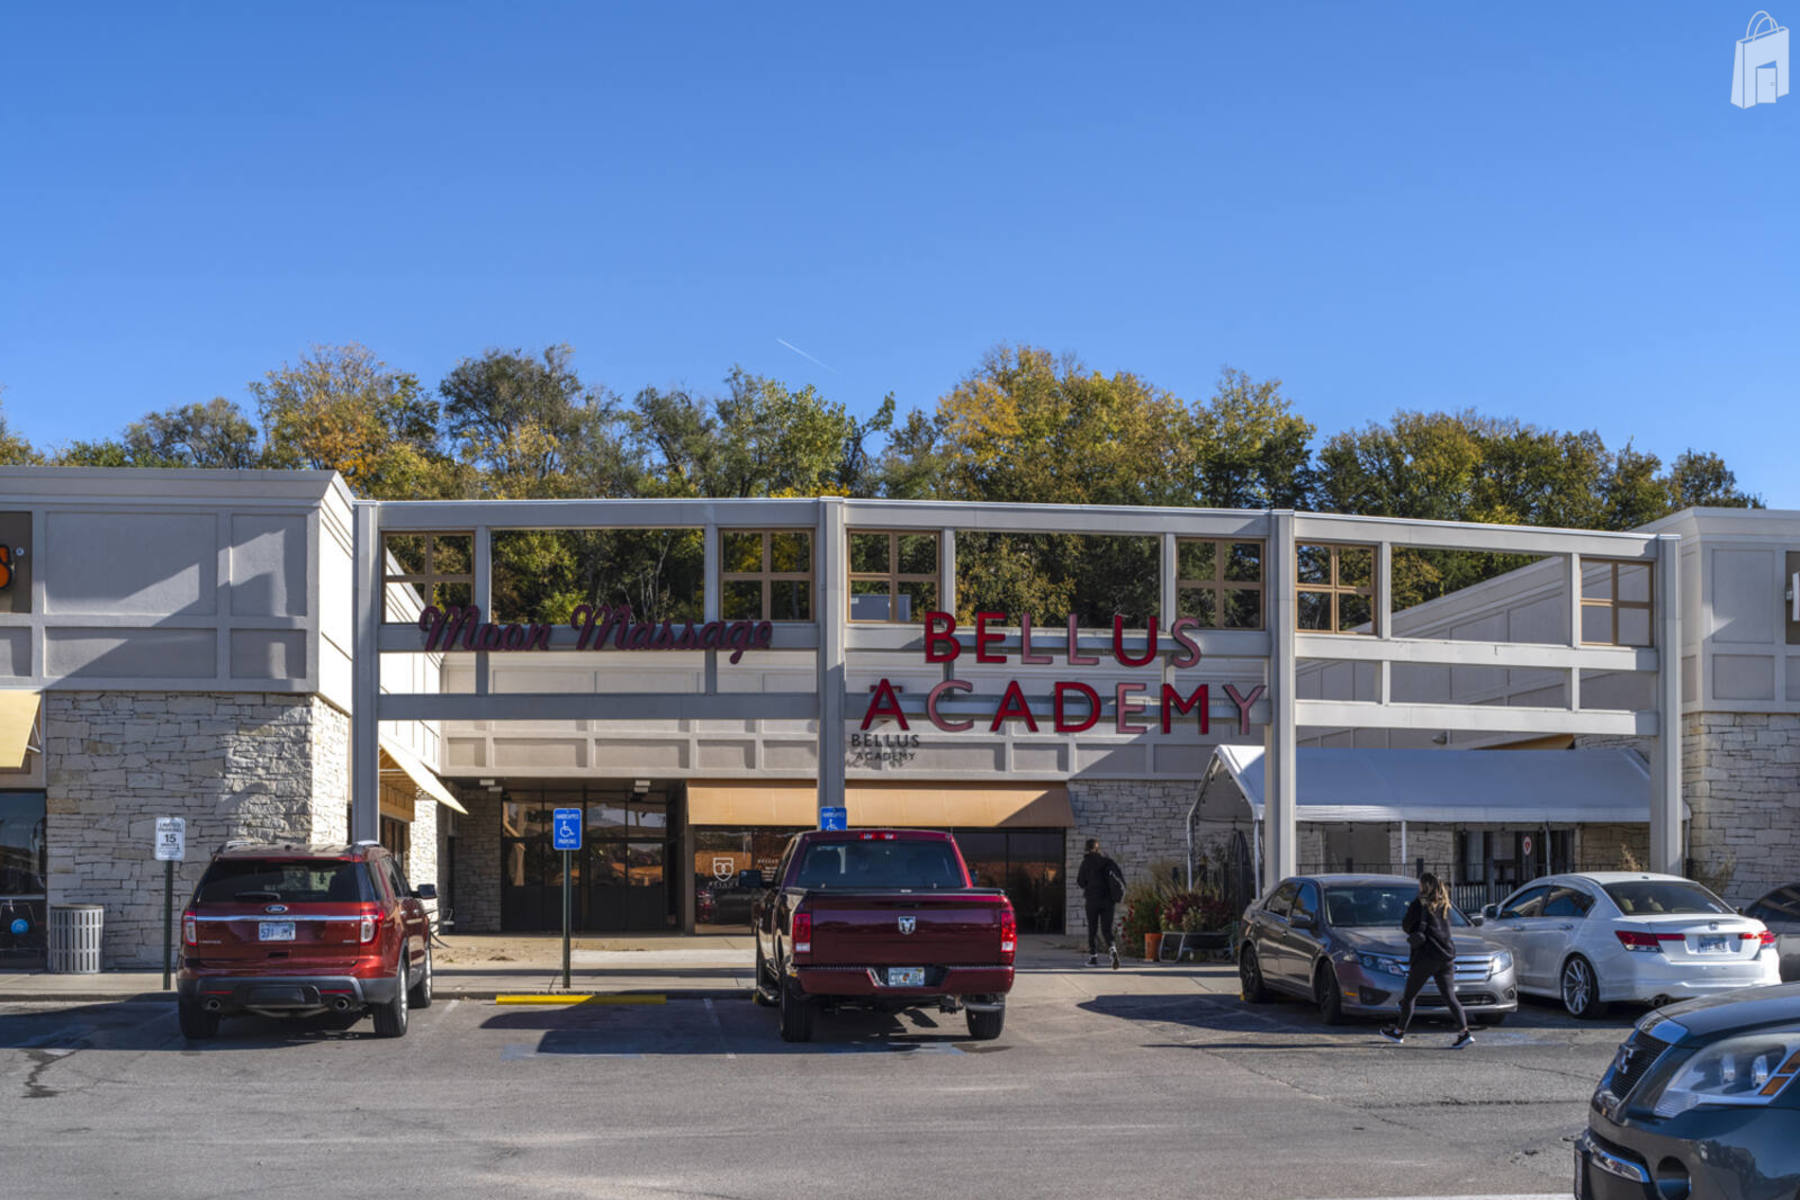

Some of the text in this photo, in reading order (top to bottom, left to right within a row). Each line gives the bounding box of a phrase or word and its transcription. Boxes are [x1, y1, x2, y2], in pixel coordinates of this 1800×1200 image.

[419, 604, 773, 665] Moon Massage
[924, 611, 1202, 668] BELLUS
[860, 678, 1266, 735] ACADEMY
[851, 733, 920, 748] BELLUS
[855, 751, 917, 761] ACADEMY
[165, 833, 177, 843] 15
